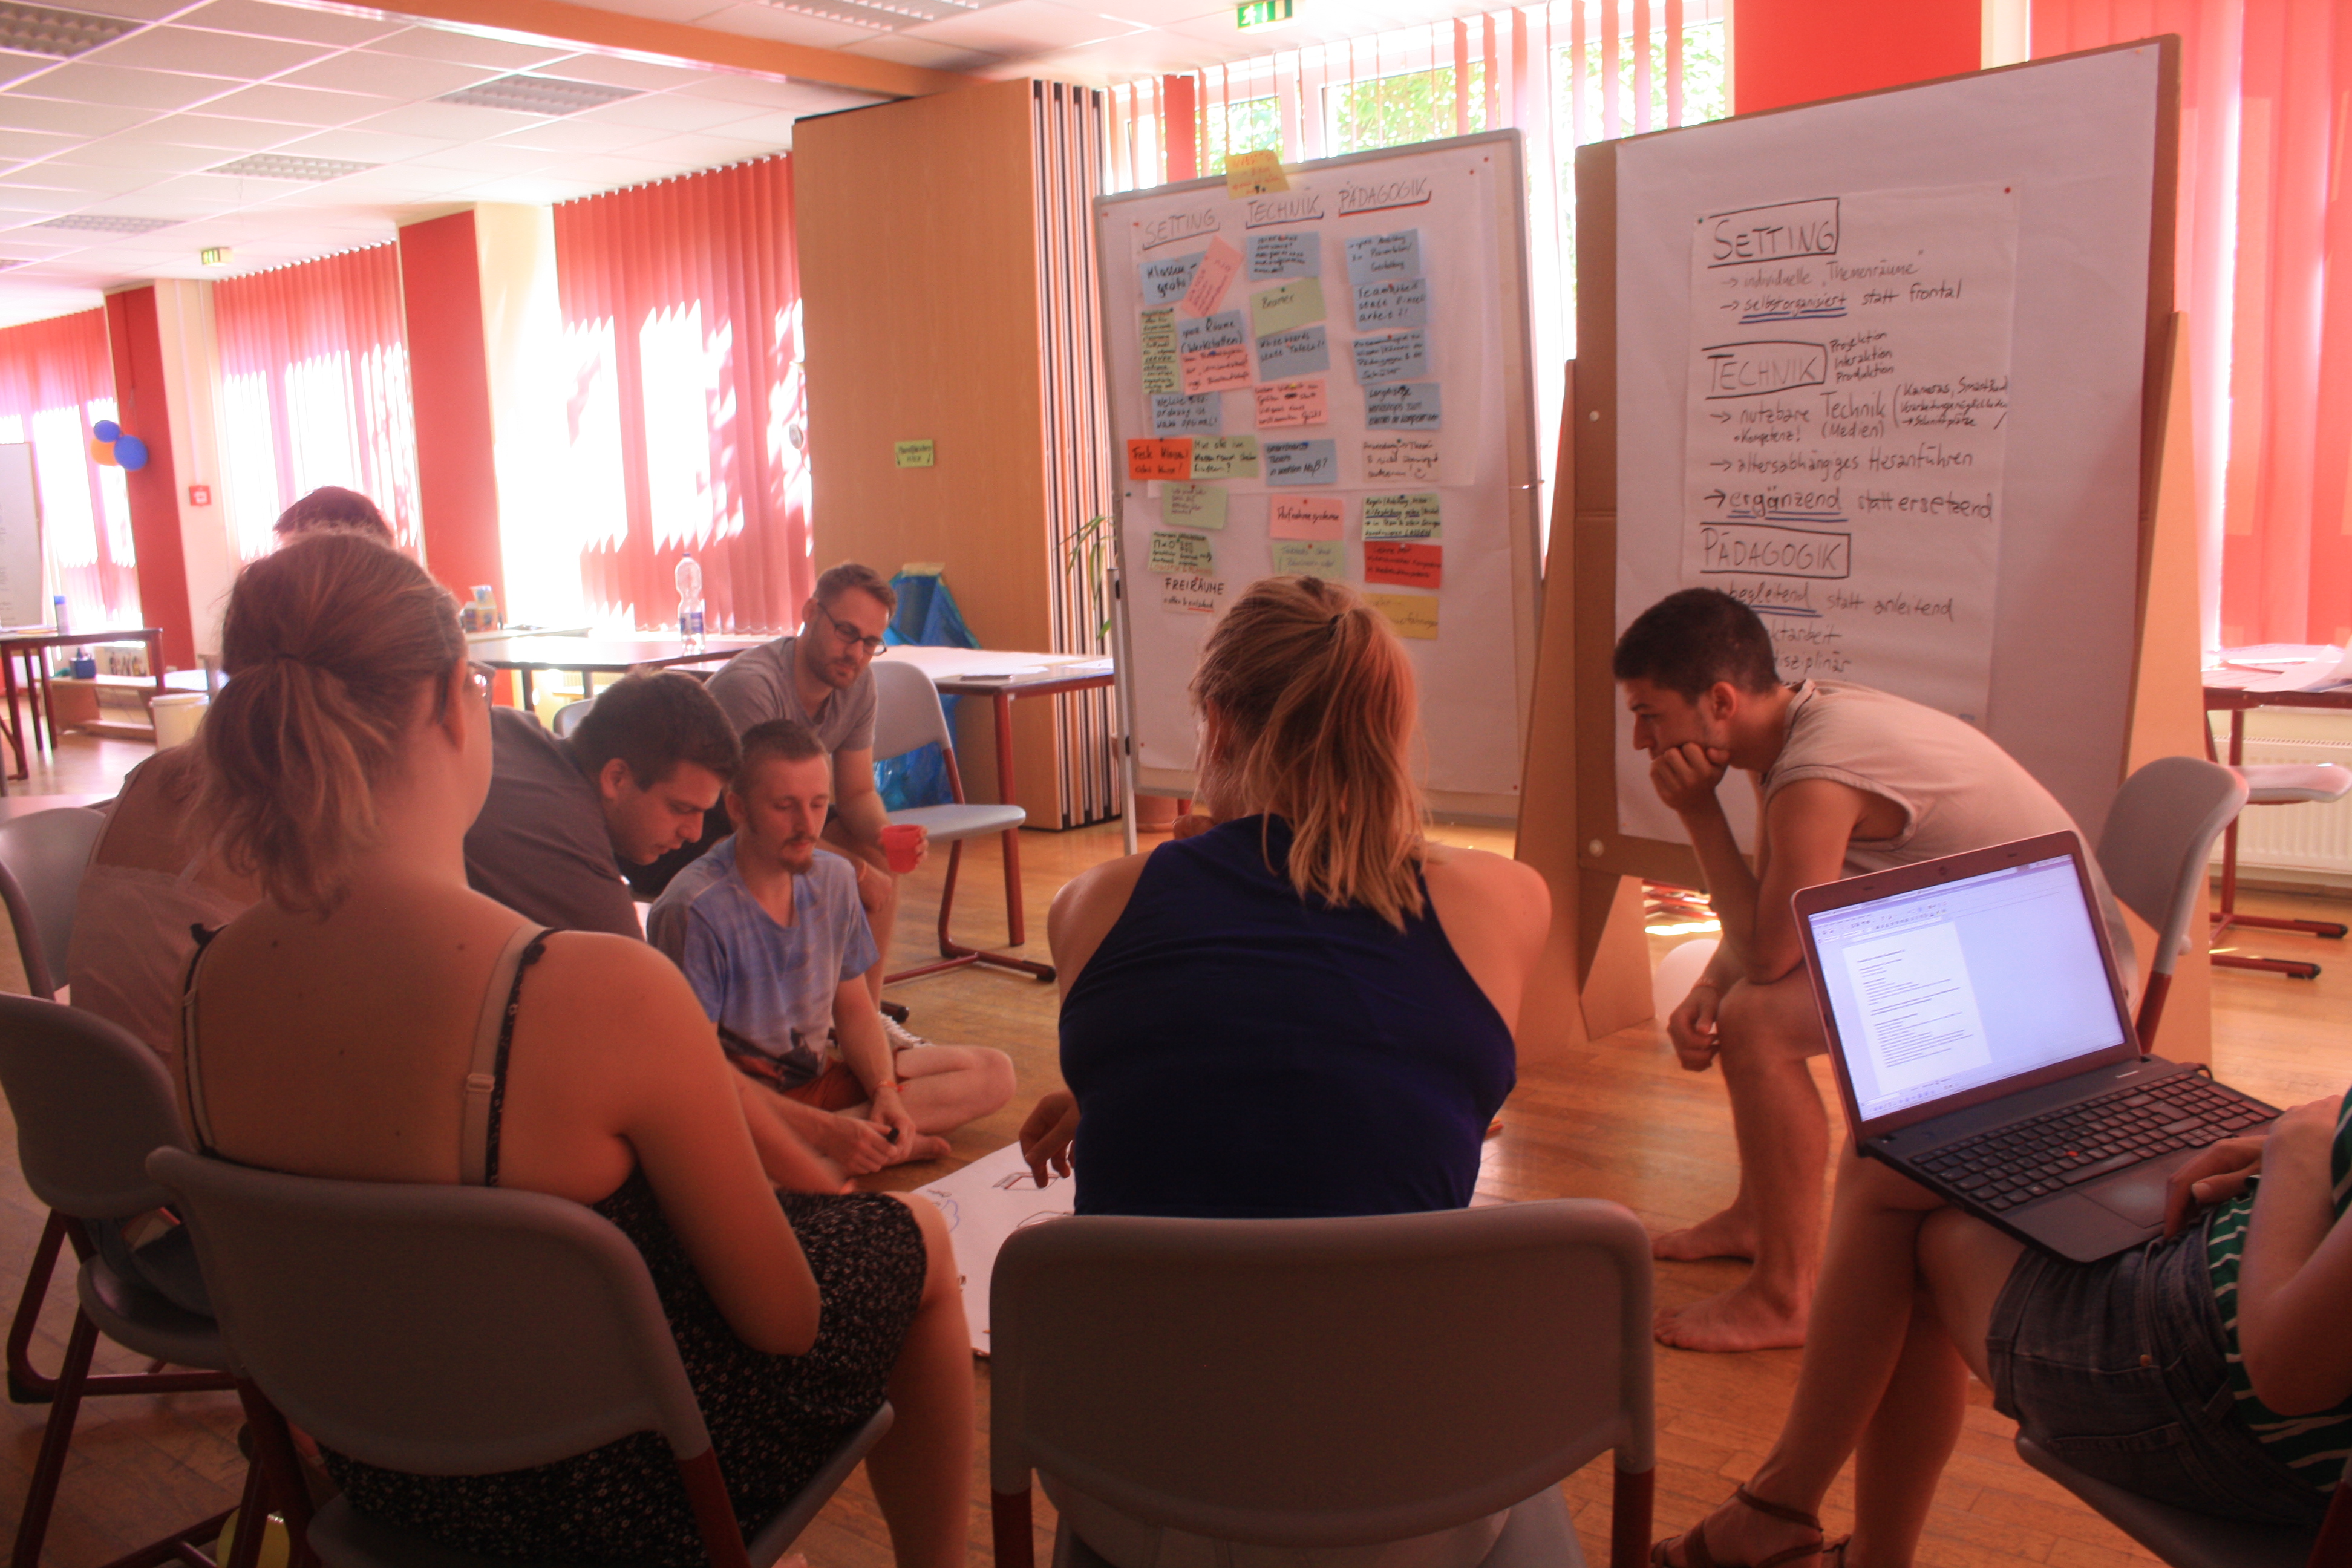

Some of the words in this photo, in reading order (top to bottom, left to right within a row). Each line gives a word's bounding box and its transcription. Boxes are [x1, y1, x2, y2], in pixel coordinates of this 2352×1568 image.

[1145, 209, 1216, 243] SETTING
[1247, 196, 1321, 223] TECHNIK
[1339, 177, 1429, 209] PÄDAGOGIK
[1713, 218, 1835, 261] SETTING
[1743, 265, 1813, 288] individuelle
[1743, 293, 1847, 316] selbstorganisiert
[1861, 288, 1900, 306] statt
[1707, 353, 1818, 393] TECHNIK
[1835, 365, 1895, 384] Produktion
[1740, 399, 1811, 425] nutzbare
[1820, 390, 1887, 420] Technik
[1821, 420, 1886, 439] (Medien)
[1737, 450, 1859, 482] altersabhängiges
[1729, 485, 1843, 518] ergänzend
[1858, 489, 1894, 514] statt
[1898, 491, 1993, 523] ersetzend
[1701, 527, 1841, 570] PÄDAGOGIK
[1165, 577, 1225, 595] FREIRÄUME
[1826, 588, 1865, 610] statt
[1873, 590, 1954, 623] anleitend
[1770, 618, 1843, 645] ktarbeit
